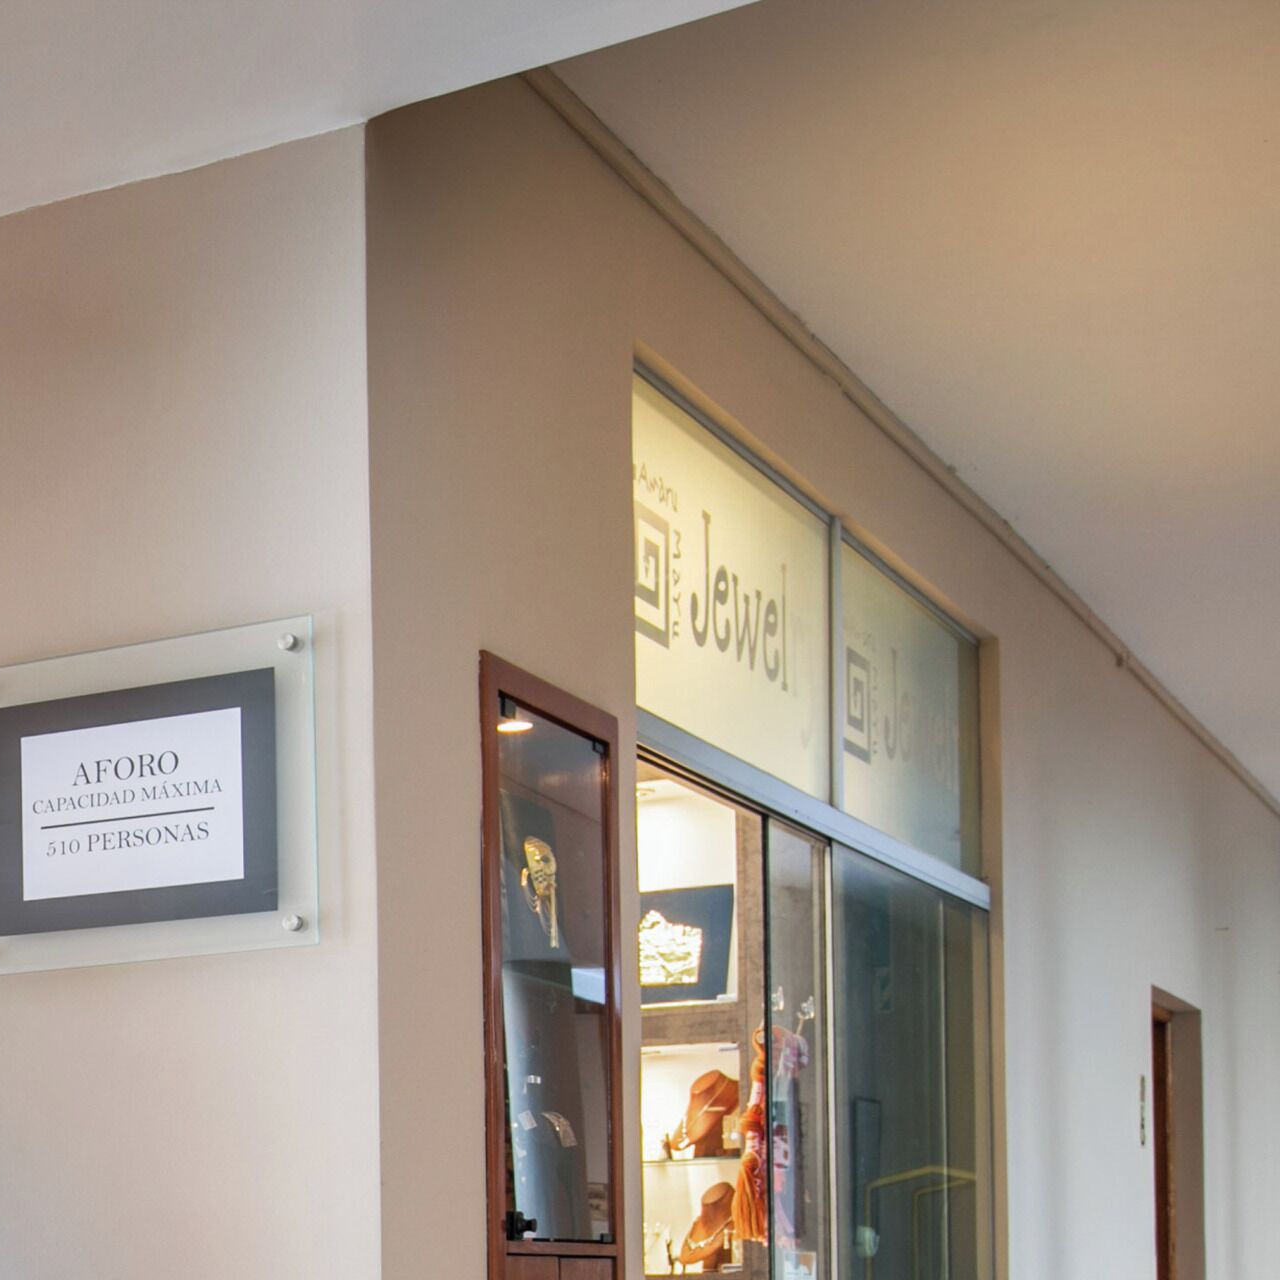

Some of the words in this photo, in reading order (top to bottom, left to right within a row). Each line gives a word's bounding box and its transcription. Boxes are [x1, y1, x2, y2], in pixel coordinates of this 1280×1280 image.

[72, 750, 179, 787] AFORO
[32, 788, 136, 815] CAPACIDAD
[141, 778, 222, 803] MÁXIMA
[46, 839, 81, 857] 510
[87, 821, 209, 852] PERSONAS
